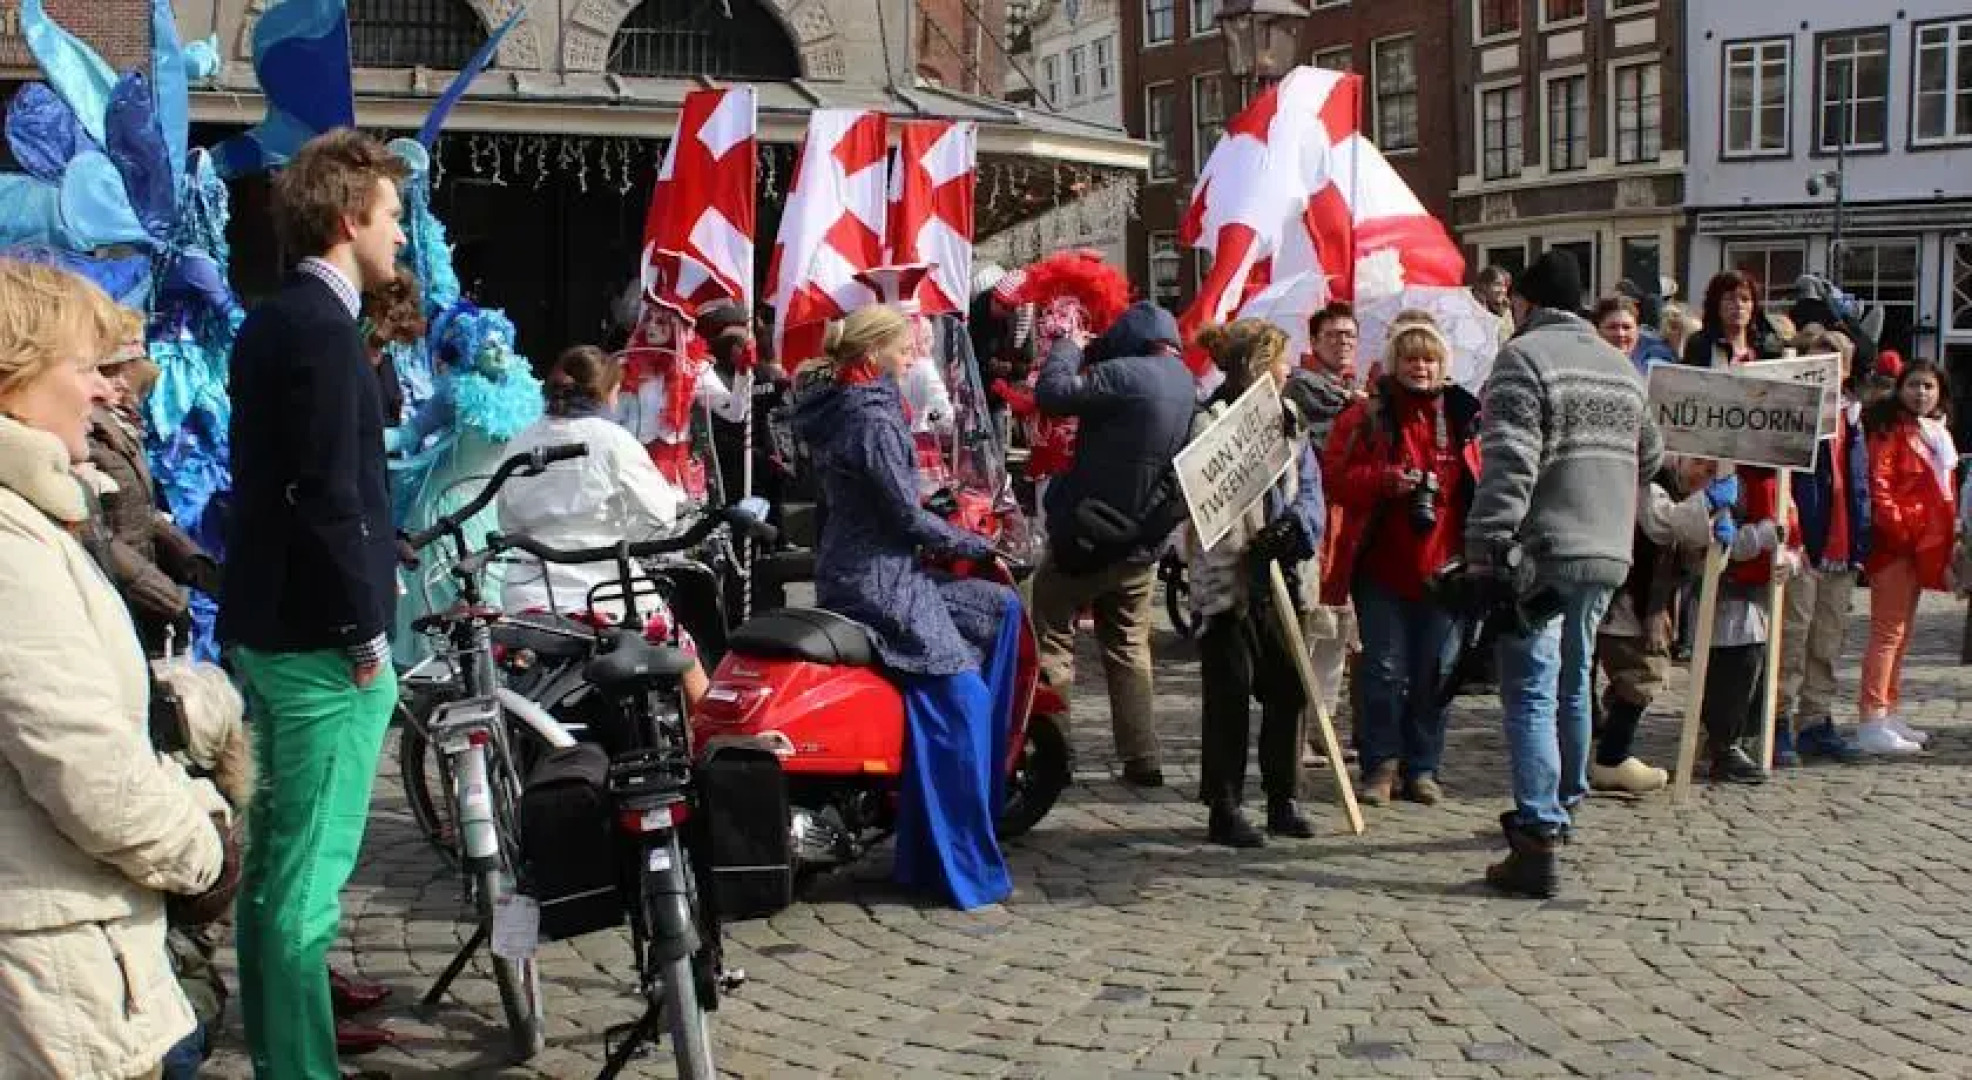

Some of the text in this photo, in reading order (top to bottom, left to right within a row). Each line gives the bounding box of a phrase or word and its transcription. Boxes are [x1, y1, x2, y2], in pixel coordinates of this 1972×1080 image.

[1659, 397, 1804, 432] NÜ HOORN
[1201, 443, 1234, 483] VAN
